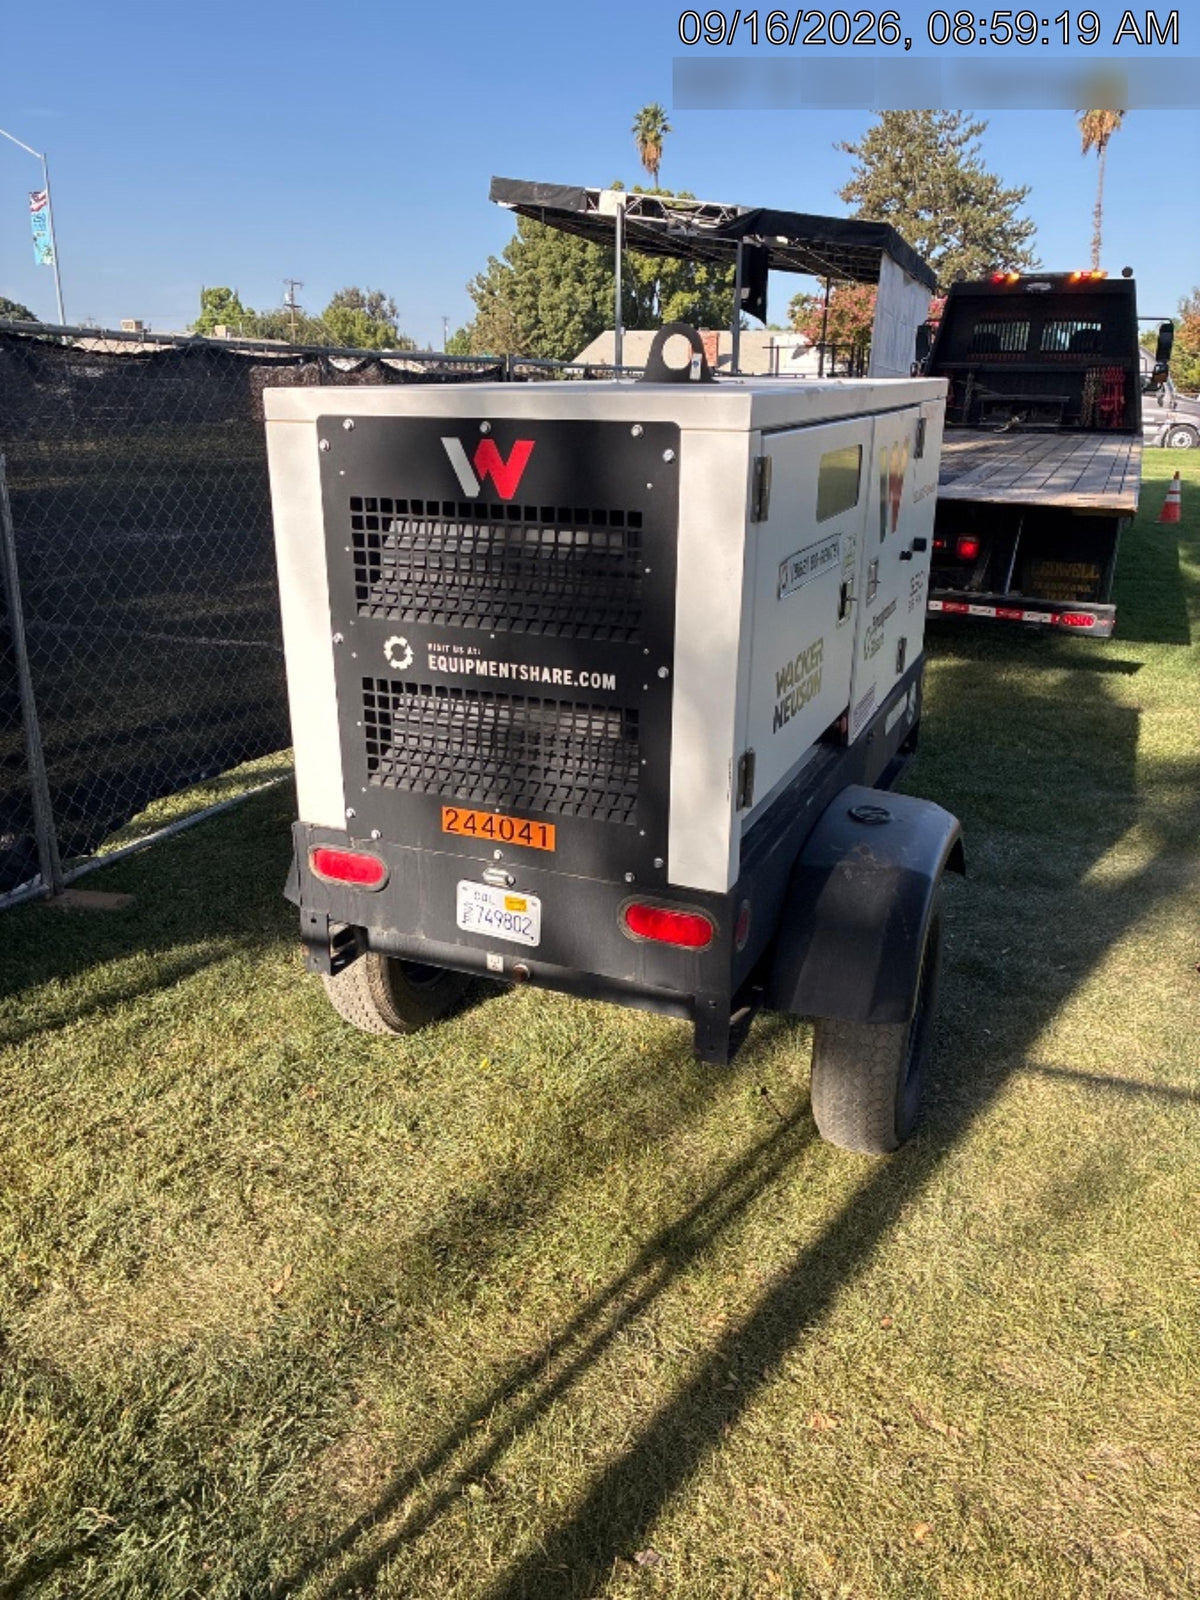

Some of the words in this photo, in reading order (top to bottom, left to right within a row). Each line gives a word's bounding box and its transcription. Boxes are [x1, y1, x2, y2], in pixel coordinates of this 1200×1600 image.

[428, 655, 617, 691] EQUIPMENTSHARE.COM
[775, 638, 824, 698] WACKER
[773, 667, 823, 734] NEUSON
[446, 808, 550, 847] 244041
[476, 904, 532, 936] 749802
